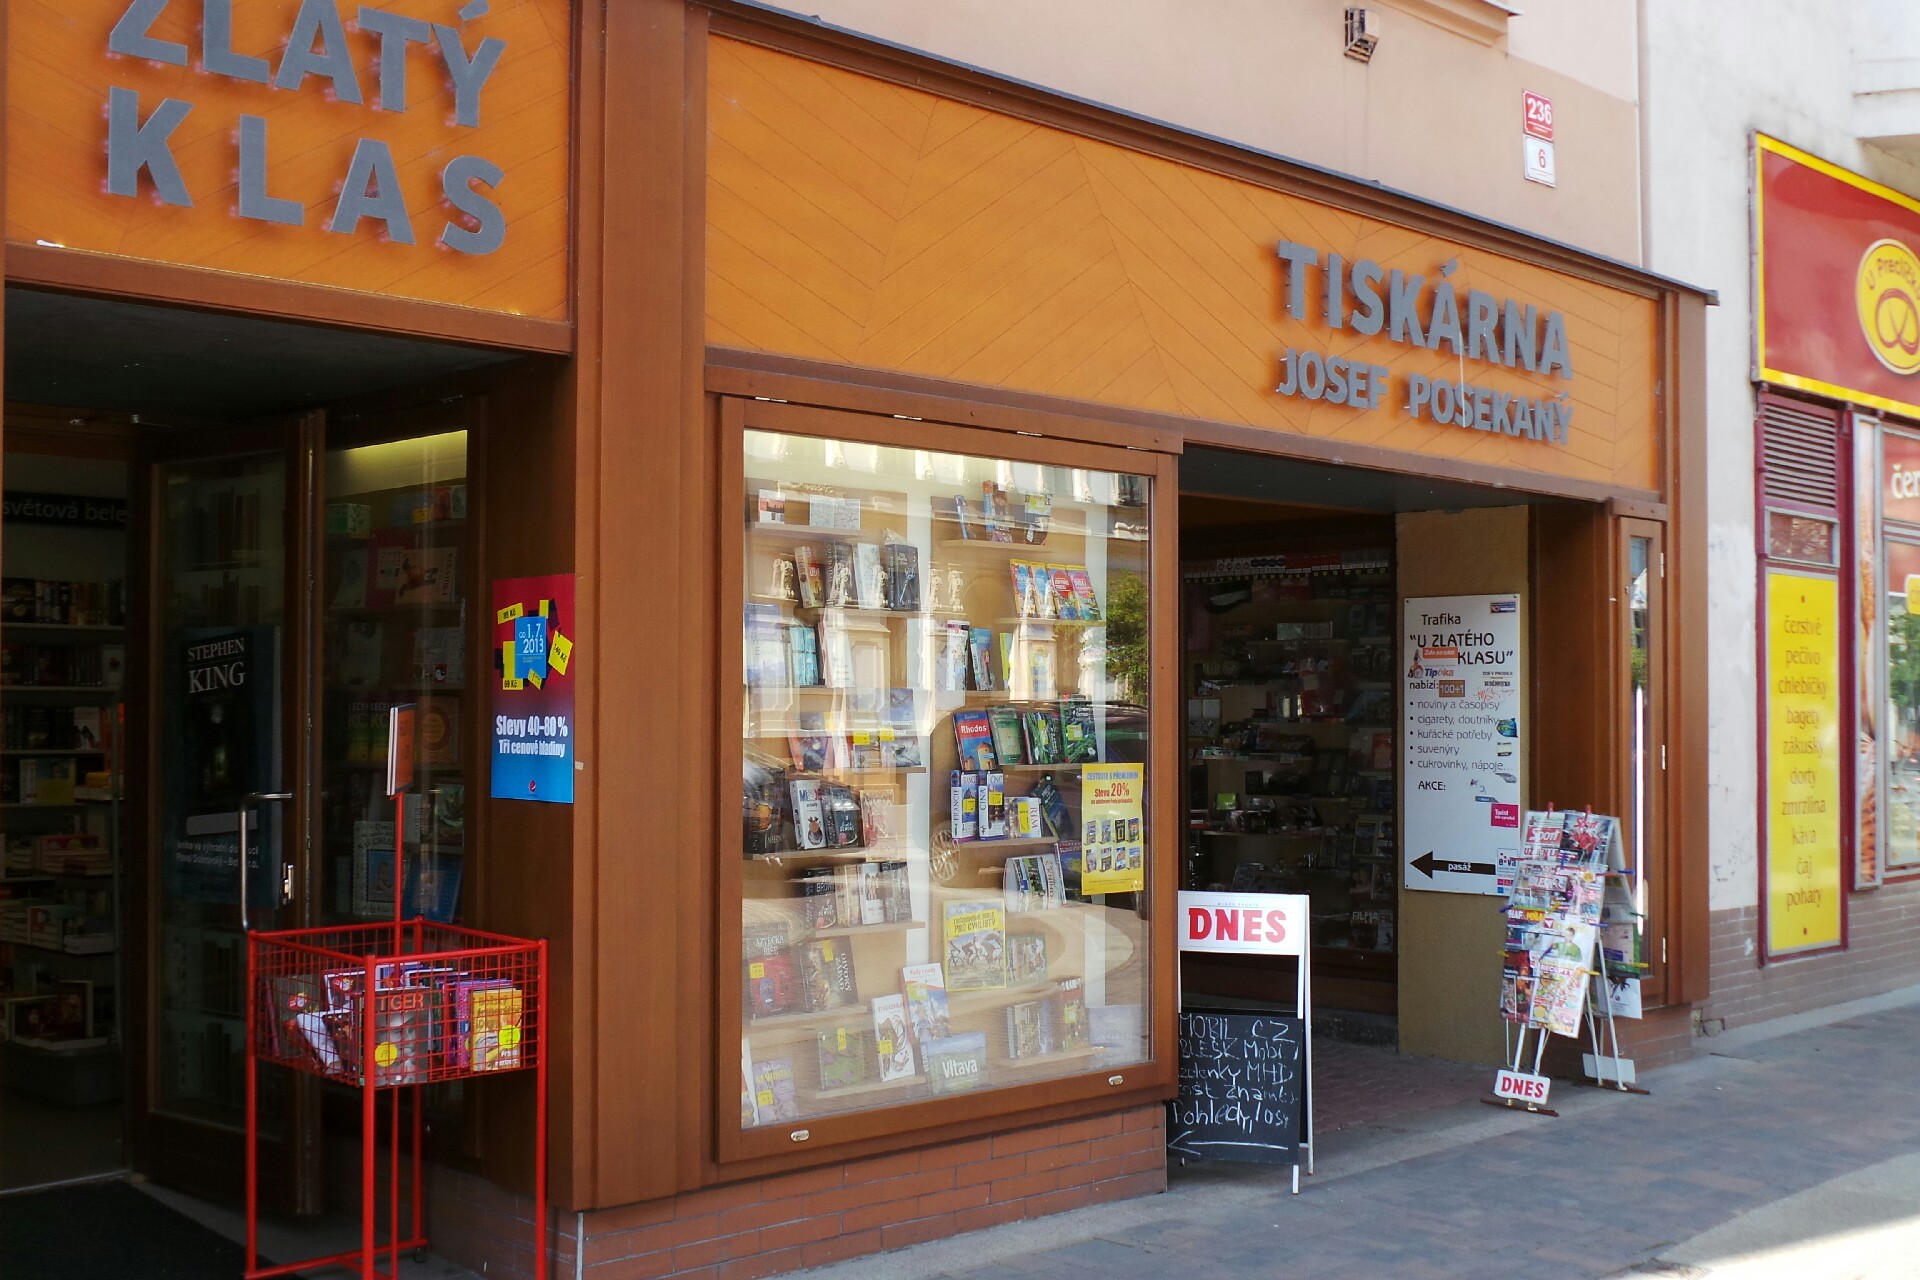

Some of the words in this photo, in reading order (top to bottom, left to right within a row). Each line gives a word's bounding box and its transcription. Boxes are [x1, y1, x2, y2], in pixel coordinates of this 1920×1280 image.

[109, 0, 507, 128] ZLATÝ
[1527, 97, 1553, 125] 236
[1539, 148, 1546, 169] 6
[107, 86, 507, 255] KLAS
[1278, 240, 1573, 380] TISKÁRNA
[1278, 347, 1389, 411] JOSEF
[1409, 372, 1574, 446] POSEKANÝ
[2, 499, 79, 521] světová
[1421, 613, 1461, 625] Trafika
[1784, 613, 1822, 636] čerstvé
[523, 637, 544, 654] 2013
[1432, 629, 1494, 647] ZLATÉHO
[187, 637, 245, 662] STEPHEN
[1785, 646, 1821, 668] pečivo
[188, 661, 246, 694] KING
[1778, 674, 1828, 701] chlebíčky
[1417, 700, 1447, 710] noviny
[1459, 699, 1500, 711] časopisy
[495, 714, 527, 738] Slevy
[961, 724, 987, 734] Rhodos
[1786, 706, 1820, 730] bagety
[1417, 729, 1454, 739] kuřácké
[1457, 731, 1493, 741] potřeby
[511, 739, 539, 755] cenové
[538, 740, 566, 758] hladiny
[1417, 744, 1460, 756] suvenýry
[1783, 735, 1824, 760] zákusky
[1417, 759, 1468, 771] cukrovinky,
[1417, 780, 1446, 791] AKCE:
[1790, 766, 1818, 789] dorty
[1094, 788, 1110, 798] Sleva
[1782, 795, 1826, 816] zmrzlina
[1528, 827, 1561, 842] Sport
[1792, 826, 1818, 846] káva
[1448, 862, 1472, 872] pasáž
[1796, 856, 1813, 880] čaj
[1786, 887, 1824, 911] poháry
[968, 917, 996, 931] CYKLISTY
[1188, 907, 1288, 943] DNES
[1179, 1013, 1238, 1041] MOBIL
[1179, 1038, 1241, 1061] BLESK
[942, 1059, 977, 1079] Vltava
[1246, 1060, 1294, 1085] MHD
[1501, 1077, 1545, 1098] DNES
